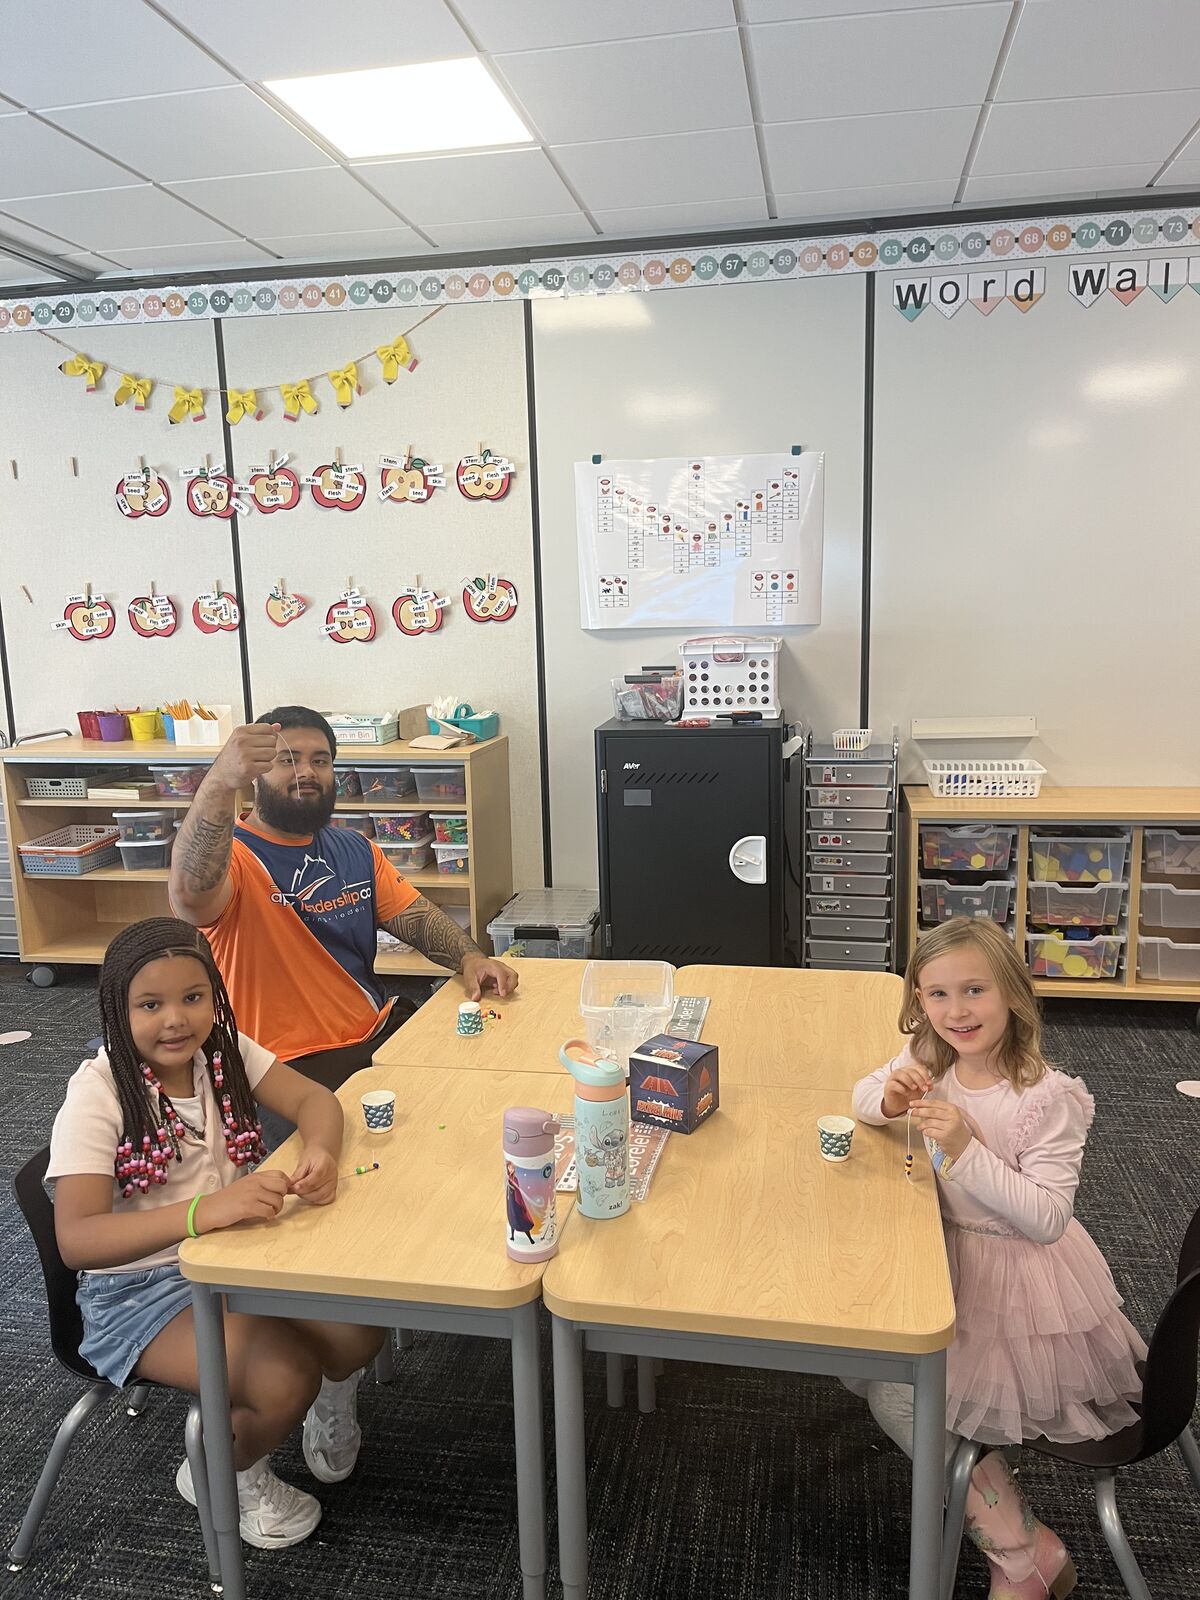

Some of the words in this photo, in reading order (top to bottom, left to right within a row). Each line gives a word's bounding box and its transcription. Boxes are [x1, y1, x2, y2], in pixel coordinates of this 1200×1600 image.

[17, 311, 27, 319] 27
[38, 308, 48, 317] 28
[60, 307, 70, 316] 29
[82, 305, 92, 314] 30
[103, 304, 114, 312] 31
[125, 303, 136, 312] 32
[148, 301, 159, 310] 33
[170, 300, 181, 309] 34
[192, 298, 203, 307] 35
[214, 296, 226, 305] 36
[237, 295, 249, 304] 37
[259, 294, 271, 303] 38
[284, 292, 295, 302] 39
[306, 290, 318, 300] 40
[329, 290, 340, 298] 41
[354, 287, 366, 297] 42
[377, 286, 389, 296] 43
[401, 284, 412, 294] 44
[425, 282, 438, 292] 45
[450, 281, 461, 290] 46
[473, 280, 485, 290] 47
[498, 278, 511, 288] 48
[522, 276, 534, 286] 49
[547, 275, 559, 285] 50
[573, 273, 585, 282] 51
[598, 271, 611, 280] 52
[623, 268, 636, 278] 53
[649, 266, 661, 276] 54
[674, 264, 688, 274] 55
[700, 262, 714, 272] 56
[726, 260, 739, 270] 57
[752, 258, 765, 268] 58
[778, 256, 792, 266] 59
[805, 253, 818, 263] 60
[831, 250, 844, 261] 61
[858, 248, 872, 258] 62
[884, 246, 898, 256] 63
[912, 244, 926, 254] 64
[940, 241, 954, 252] 65
[968, 238, 982, 249] 66
[996, 236, 1010, 246] 67
[1024, 233, 1039, 244] 68
[1053, 231, 1067, 242] 69
[1081, 229, 1096, 240] 70
[1110, 227, 1124, 238] 71
[1140, 225, 1154, 235] 72
[1168, 222, 1183, 233] 73
[895, 270, 1034, 311] word
[1072, 262, 1170, 296] wal
[608, 1200, 623, 1210] zak!
